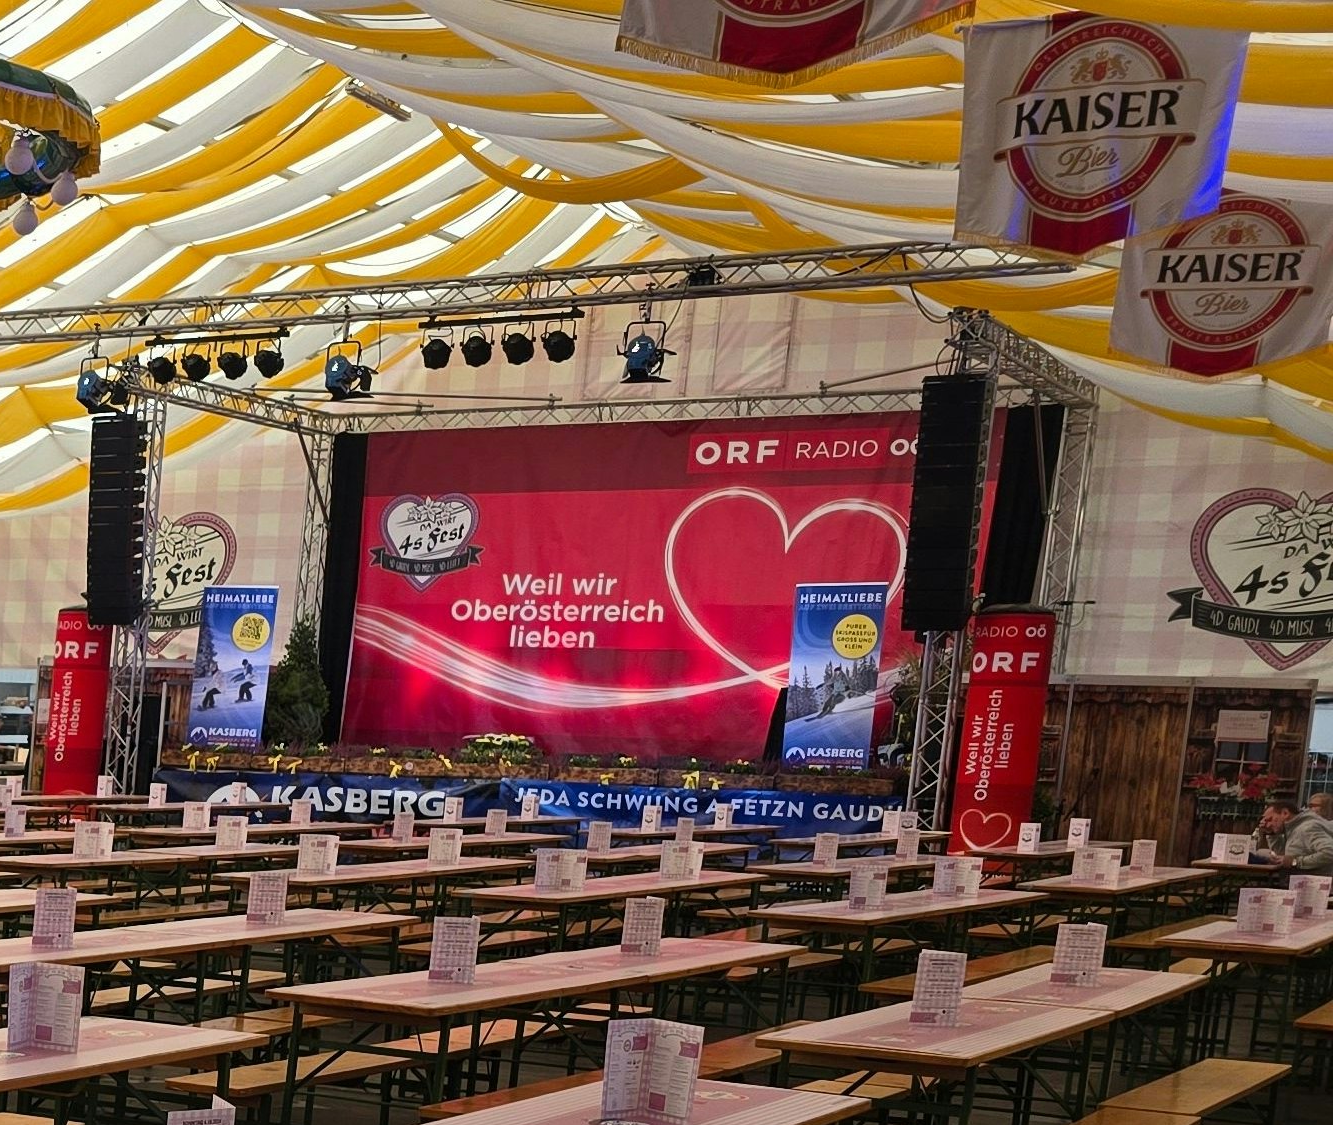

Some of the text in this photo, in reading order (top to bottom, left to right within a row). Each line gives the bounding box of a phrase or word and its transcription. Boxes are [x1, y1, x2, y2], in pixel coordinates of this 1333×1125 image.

[1013, 87, 1181, 139] KAISER
[1056, 147, 1119, 178] Bier
[1157, 250, 1304, 284] KAISER
[1193, 292, 1250, 317] Bier
[695, 439, 879, 466] ORF RADIO
[176, 547, 204, 561] WIRT
[1283, 542, 1309, 559] DA
[164, 557, 216, 599] Fest
[502, 573, 618, 597] Weil wir
[1233, 564, 1291, 605] 4s
[206, 593, 275, 604] HEIMATLIEBE
[450, 598, 665, 625] Oberösterreich
[800, 592, 883, 604] HEIMATLIEBE
[509, 624, 595, 649] lieben
[1025, 624, 1047, 638] OÖ
[972, 652, 1040, 673] ORF
[49, 691, 61, 741] Weil wir
[54, 671, 73, 762] Oberösterreich
[68, 698, 82, 736] lieben
[208, 727, 258, 738] KASBERG
[965, 714, 984, 775] Weil wir
[974, 689, 1004, 801] Oberösterreich
[994, 723, 1015, 769] lieben
[806, 747, 864, 758] KASBERG
[271, 786, 446, 817] KASBERG
[731, 798, 804, 819] FETZN
